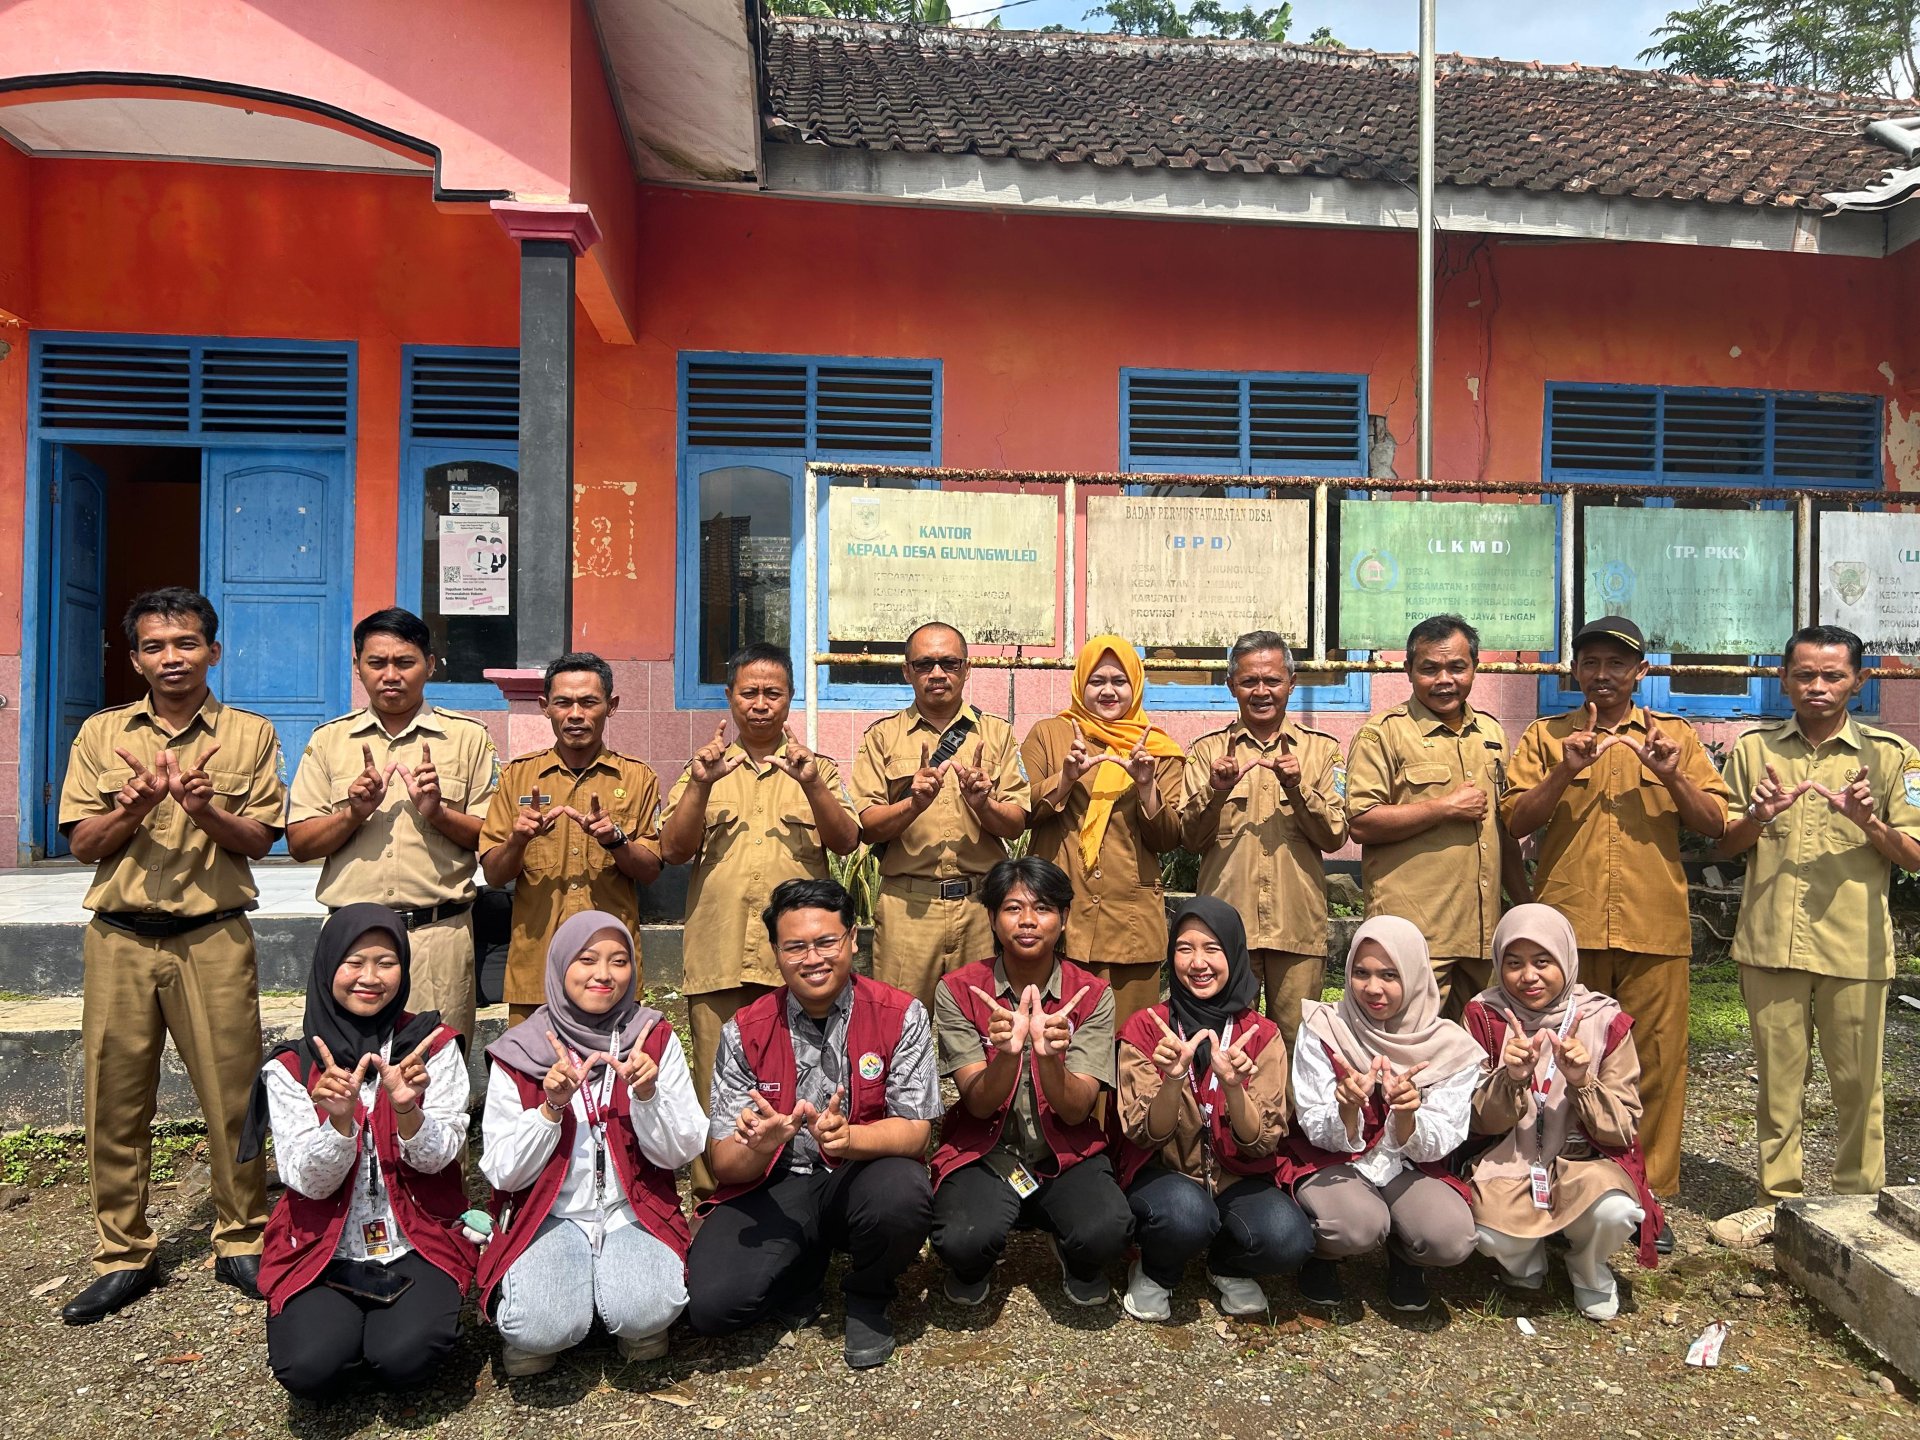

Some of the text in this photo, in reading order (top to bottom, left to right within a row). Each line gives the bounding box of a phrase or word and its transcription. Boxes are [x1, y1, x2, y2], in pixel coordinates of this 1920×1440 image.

[1125, 505, 1273, 522] BADAN PERMUSYAWARATAN DESA
[919, 525, 972, 540] KANTOR
[847, 542, 1038, 562] KEPALA DESA GUNUNGWULED
[1405, 567, 1431, 576] DESA
[1878, 576, 1902, 586] DESA
[1405, 583, 1463, 591] KECAMATAN
[1405, 597, 1461, 606] KABUPATEN
[1471, 598, 1537, 607] PURBALINGGA
[1470, 612, 1497, 621] JAWA
[1499, 613, 1537, 621] TENGAH
